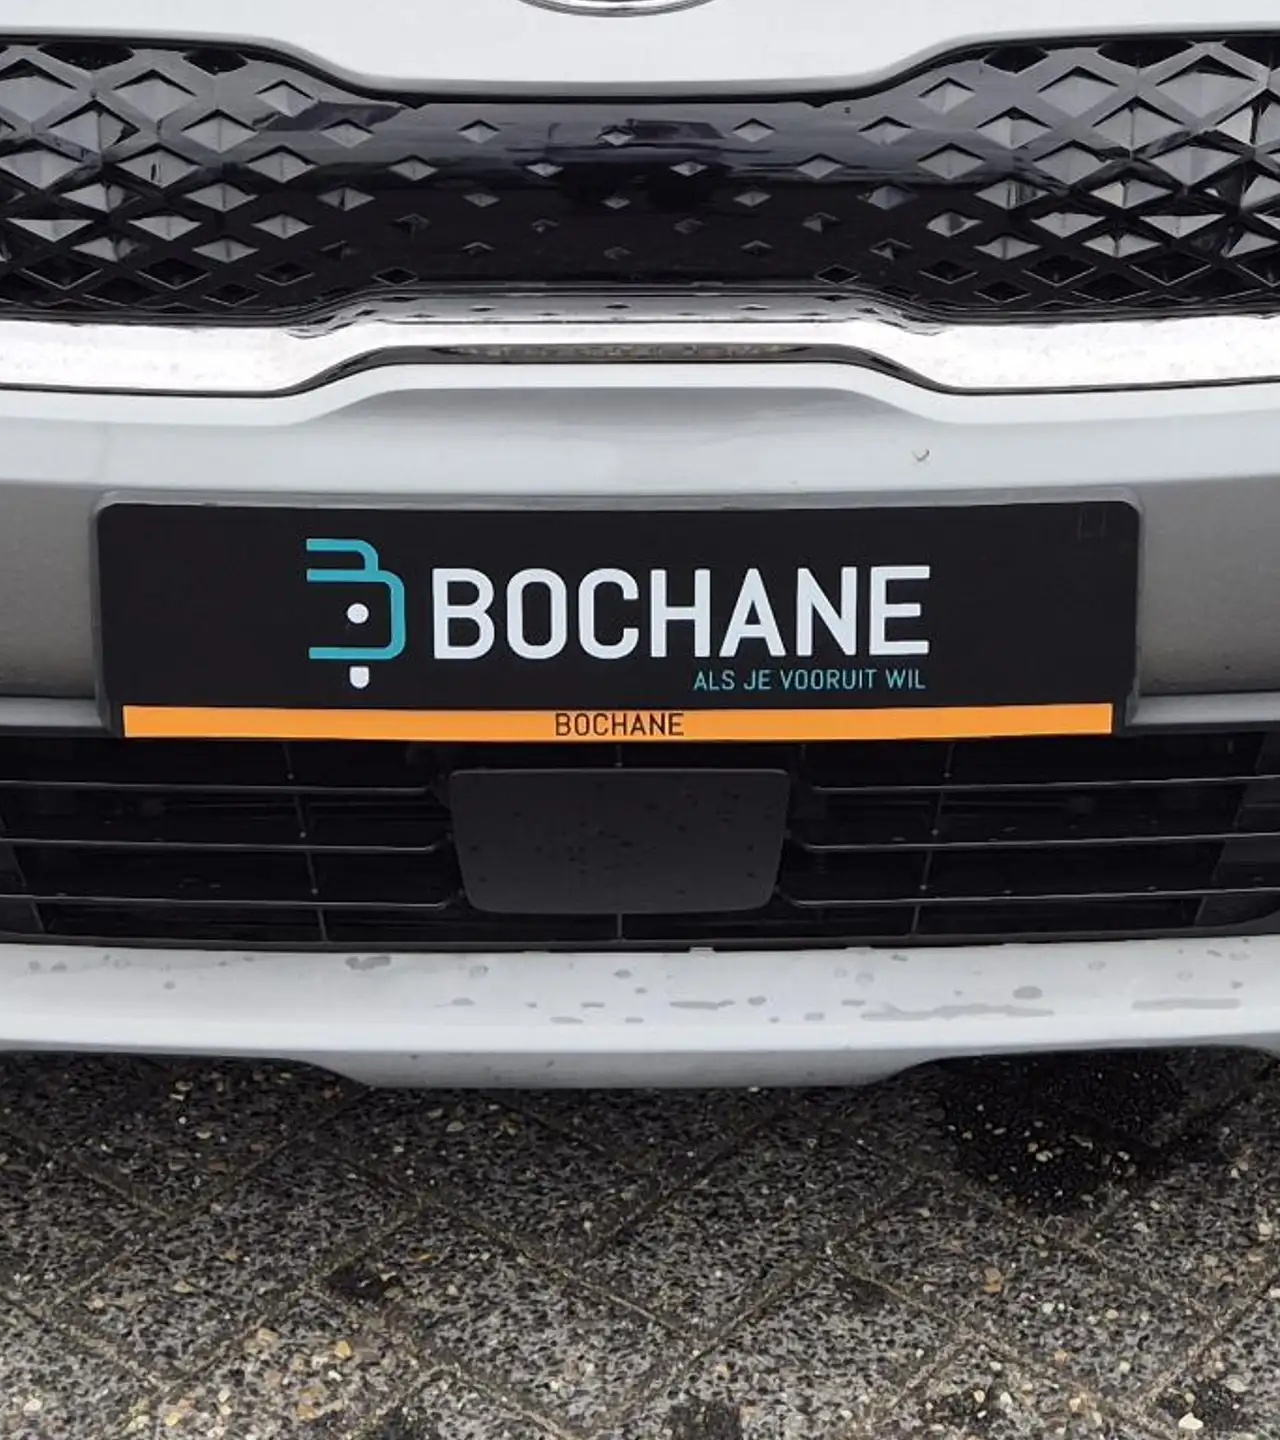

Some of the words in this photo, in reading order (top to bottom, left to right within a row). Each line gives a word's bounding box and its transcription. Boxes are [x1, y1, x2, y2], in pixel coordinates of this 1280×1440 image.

[432, 565, 931, 660] BOCHANE
[693, 668, 736, 691] ALS
[743, 669, 771, 690] JE
[780, 668, 877, 690] VOORUIT
[885, 668, 926, 690] WIL
[555, 712, 685, 737] BOCHANE
